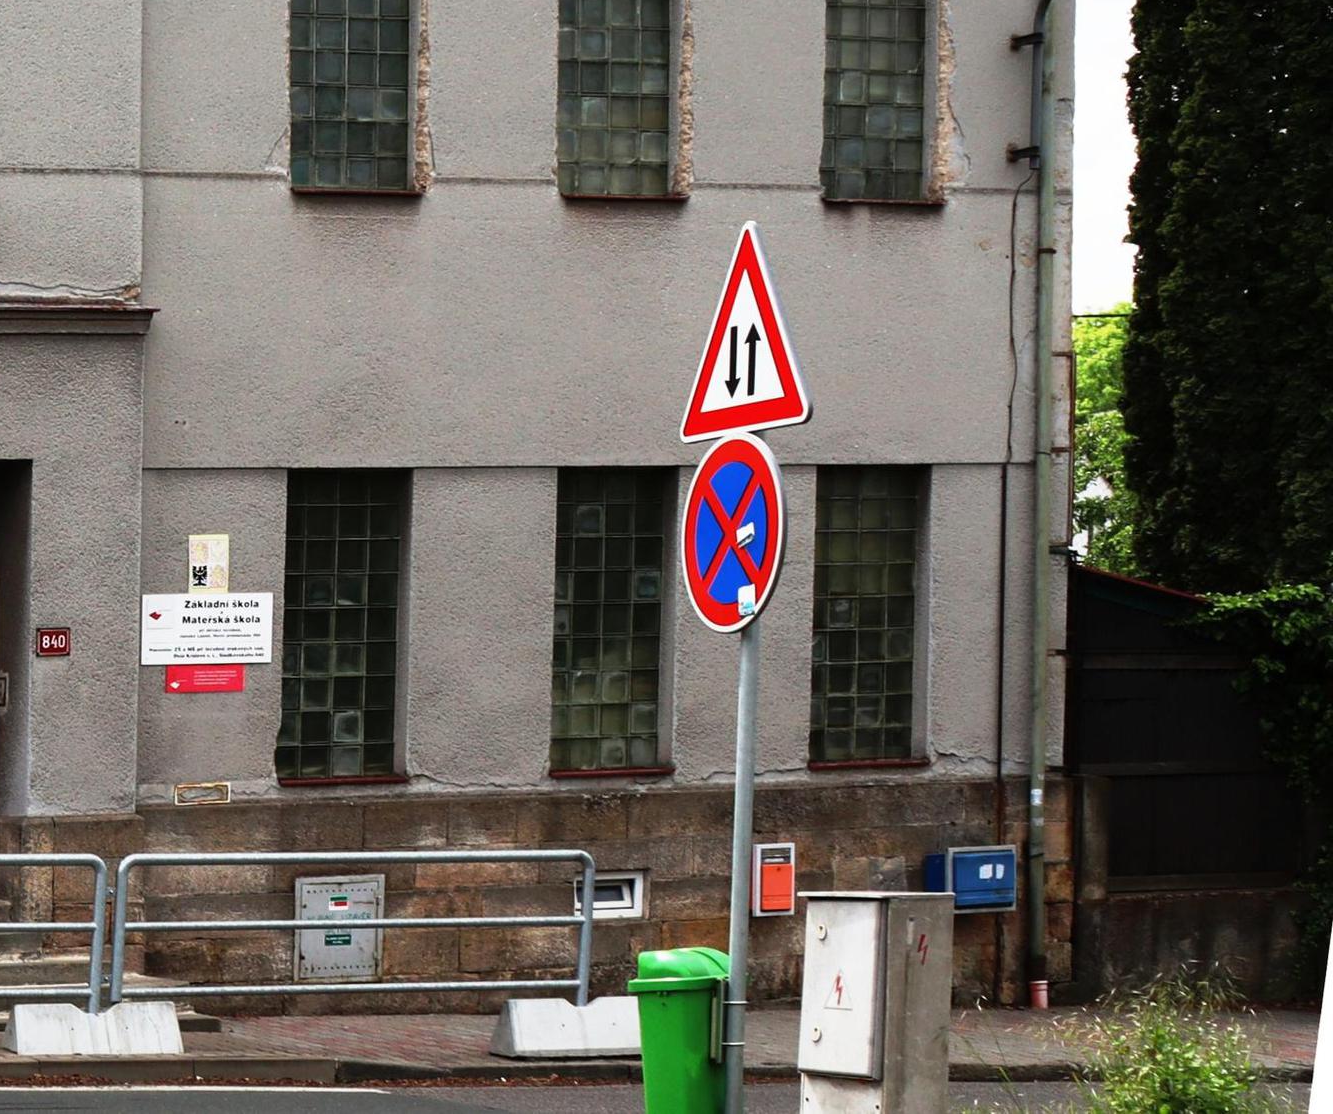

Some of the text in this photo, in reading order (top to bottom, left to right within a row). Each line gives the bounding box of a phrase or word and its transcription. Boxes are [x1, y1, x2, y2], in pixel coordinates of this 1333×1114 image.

[184, 599, 260, 609] Základní škola
[182, 615, 261, 624] Mateřská škola
[42, 634, 66, 649] 840
